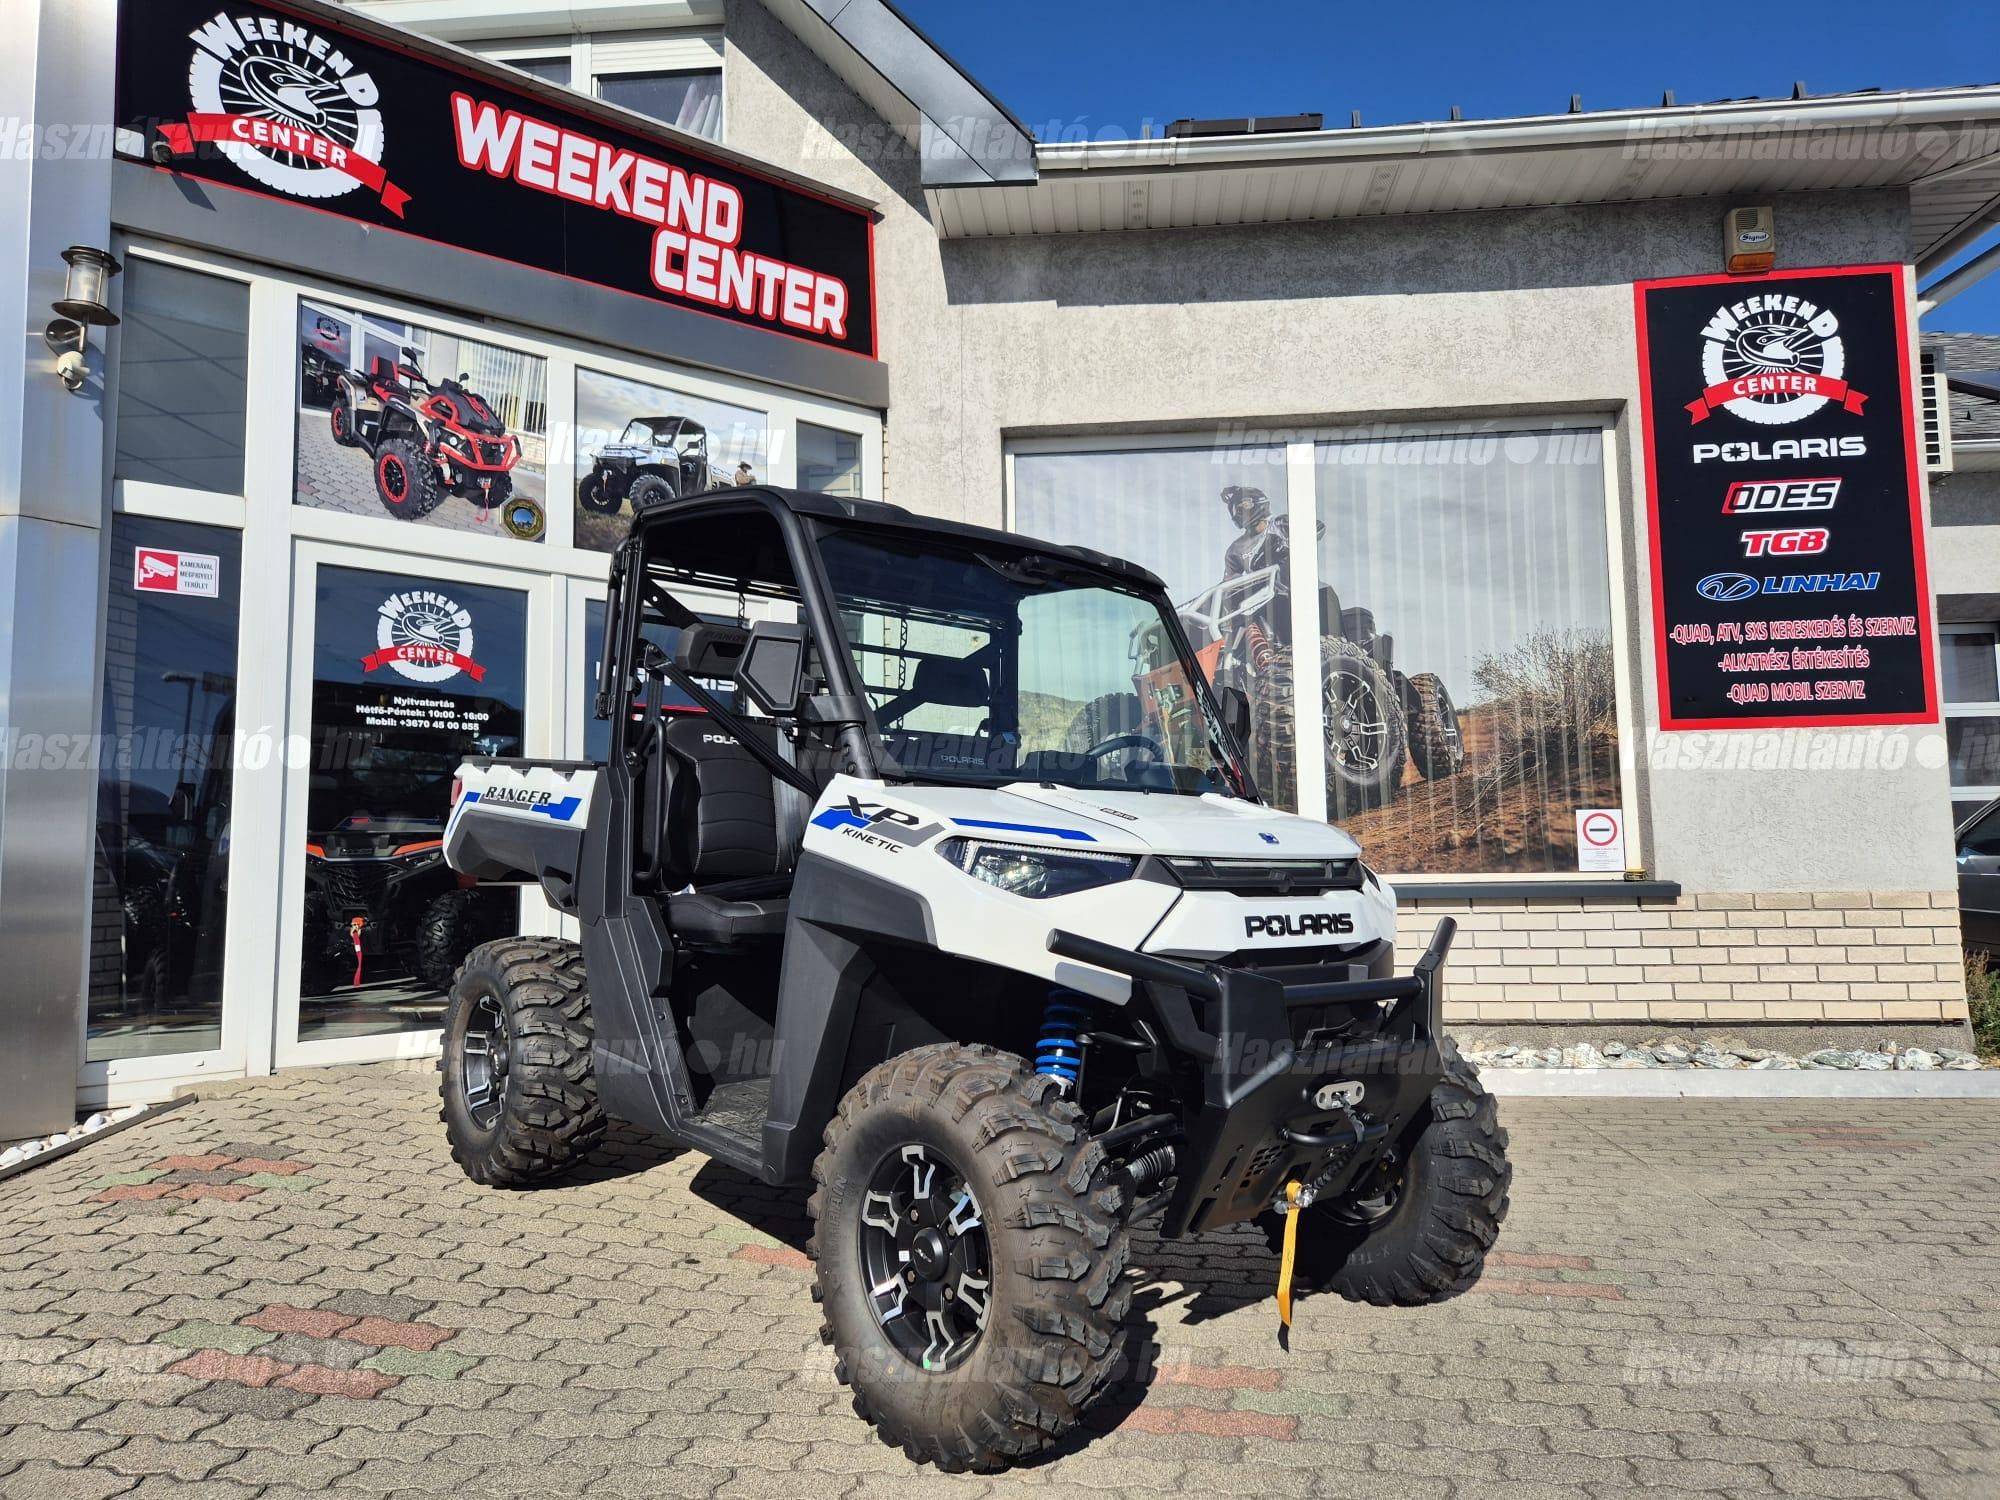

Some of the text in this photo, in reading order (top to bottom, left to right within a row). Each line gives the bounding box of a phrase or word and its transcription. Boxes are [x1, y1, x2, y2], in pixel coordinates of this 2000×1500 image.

[188, 11, 380, 107] WEEKEND
[231, 118, 349, 169] CENTER
[453, 95, 742, 245] WEEKEND
[653, 228, 846, 338] CENTER
[1699, 293, 1840, 341] WEEKEND
[1732, 375, 1818, 397] CENTER
[1692, 435, 1868, 465] POLARIS
[1742, 528, 1829, 557] TGB
[1760, 571, 1881, 595] LINHAI
[377, 590, 472, 629] WEEKEND
[1716, 621, 1744, 644] ATV,
[1745, 621, 1767, 641] SXS
[1770, 614, 1846, 640] KERESKEDÉS
[1848, 613, 1864, 638] ÉS
[1865, 616, 1917, 637] SZERVIZ
[396, 647, 455, 664] CENTER
[1718, 644, 1870, 672] -ALKATRÉSZ ÉRTÉKESÍTÉS
[393, 696, 455, 709] Nyitvatartás
[1726, 680, 1866, 705] -QUAD MOBIL SZERVIZ
[366, 716, 397, 726] Mobil:
[428, 709, 455, 720] 10:00
[940, 754, 985, 766] POLARIS
[484, 786, 552, 806] RANGER
[827, 794, 920, 826] XP
[841, 827, 904, 854] KINETIC
[1243, 912, 1355, 938] POLARIS
